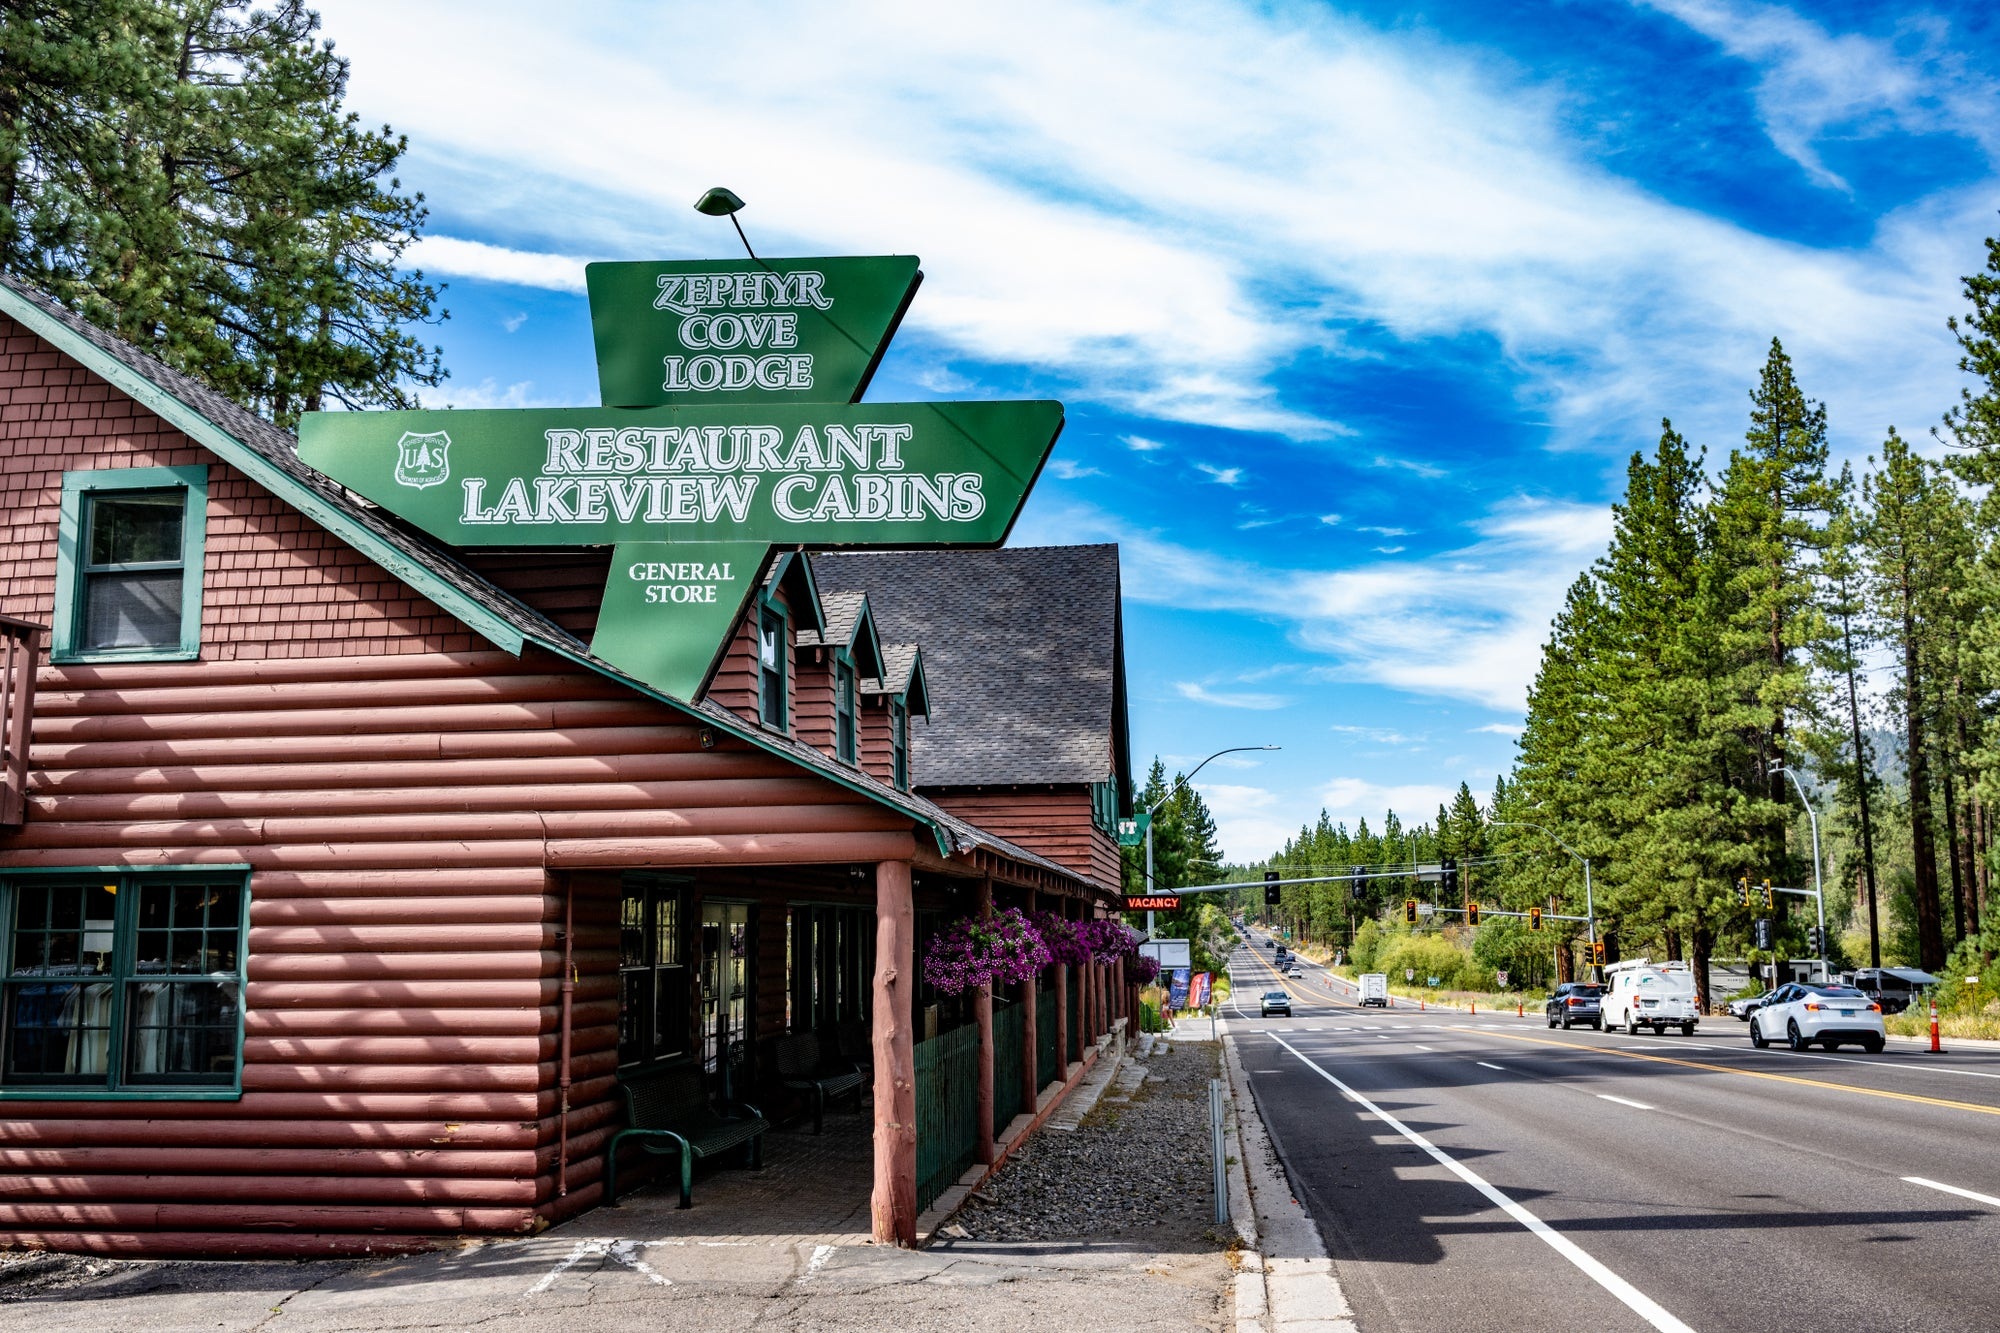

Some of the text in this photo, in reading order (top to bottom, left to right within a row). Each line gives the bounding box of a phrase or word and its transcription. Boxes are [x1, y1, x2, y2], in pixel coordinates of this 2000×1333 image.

[653, 271, 834, 316] ZEPHYR
[678, 312, 798, 350] COVE
[663, 354, 813, 391] LODGE
[542, 424, 913, 475] RESTAURANT
[459, 472, 986, 524] LAKEVIEW CABINS
[629, 563, 735, 581] GENERAL
[645, 585, 717, 603] STORE
[1128, 898, 1179, 907] VACANCY
